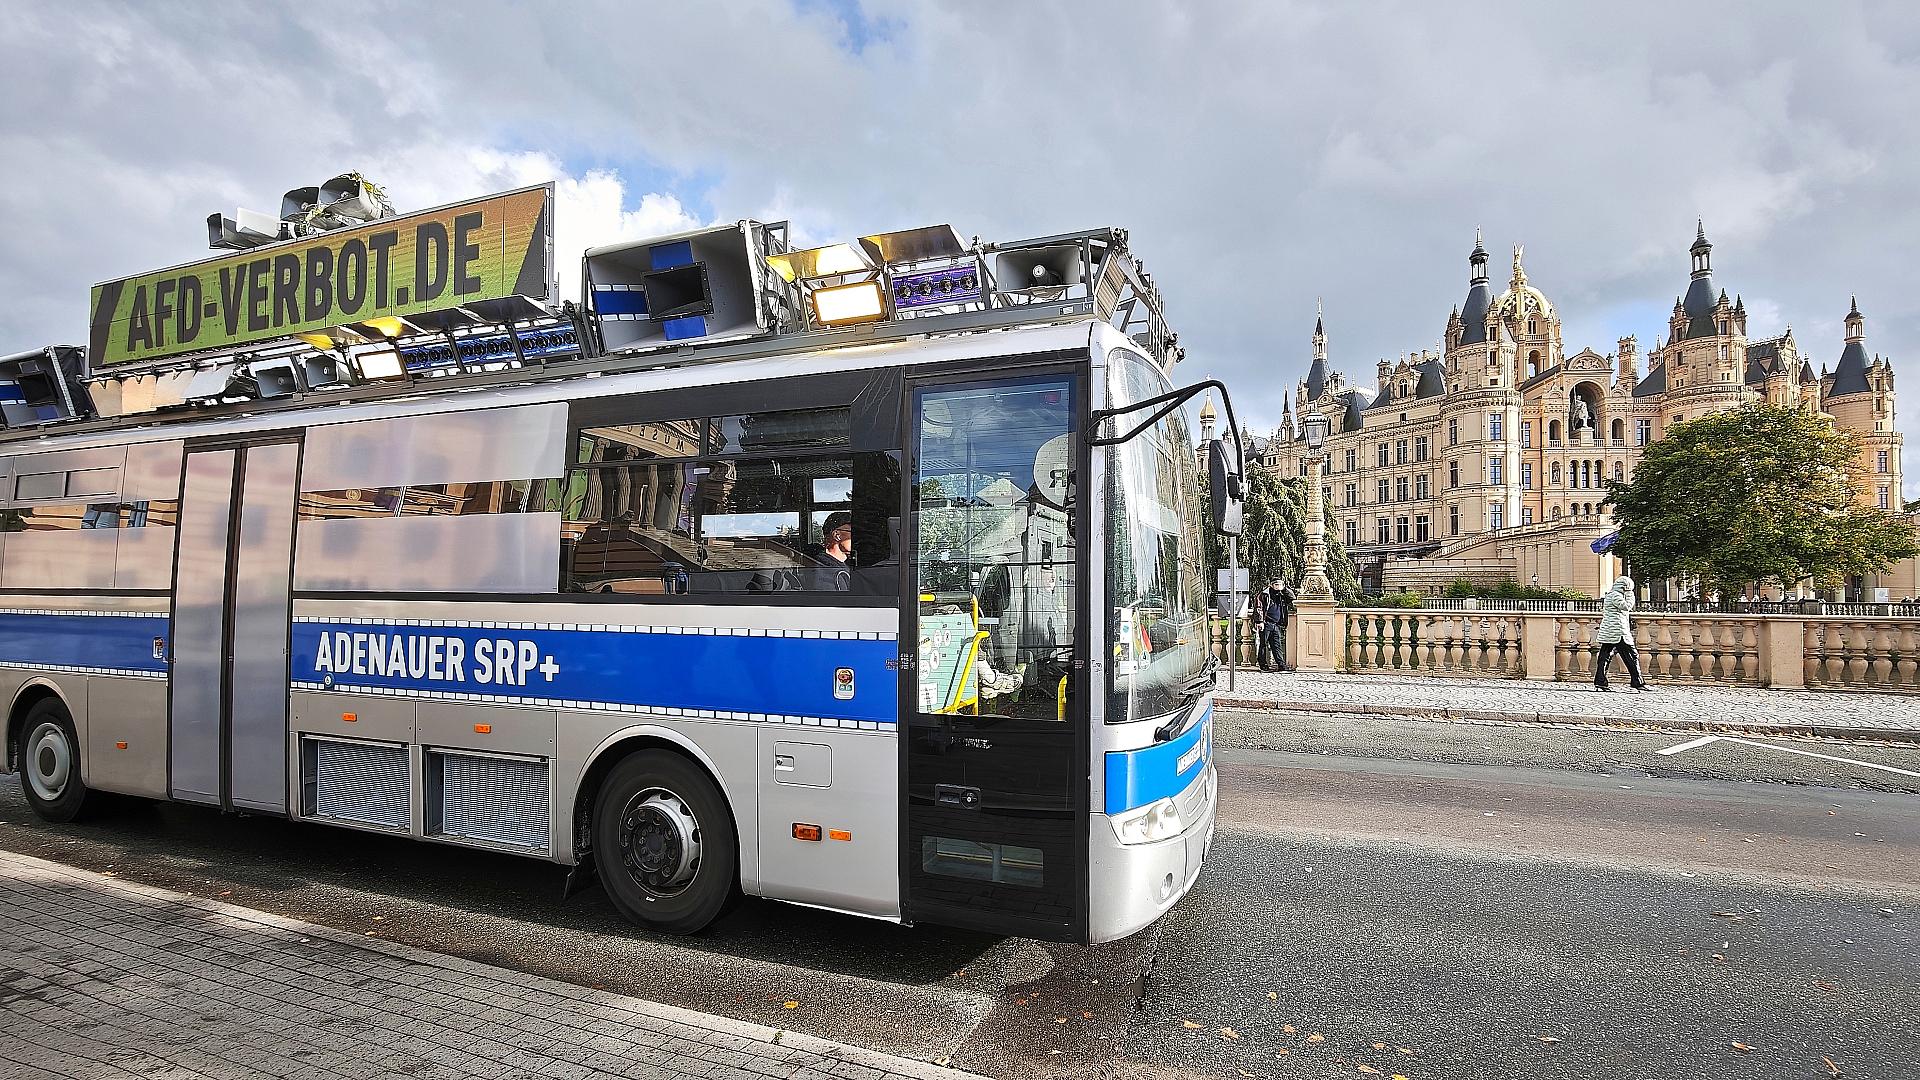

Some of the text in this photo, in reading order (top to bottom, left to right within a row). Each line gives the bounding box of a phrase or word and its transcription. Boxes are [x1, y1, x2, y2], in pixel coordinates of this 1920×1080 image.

[127, 212, 484, 352] AFD-VERBOT.DE
[315, 631, 560, 686] ADENAUER SRP+
